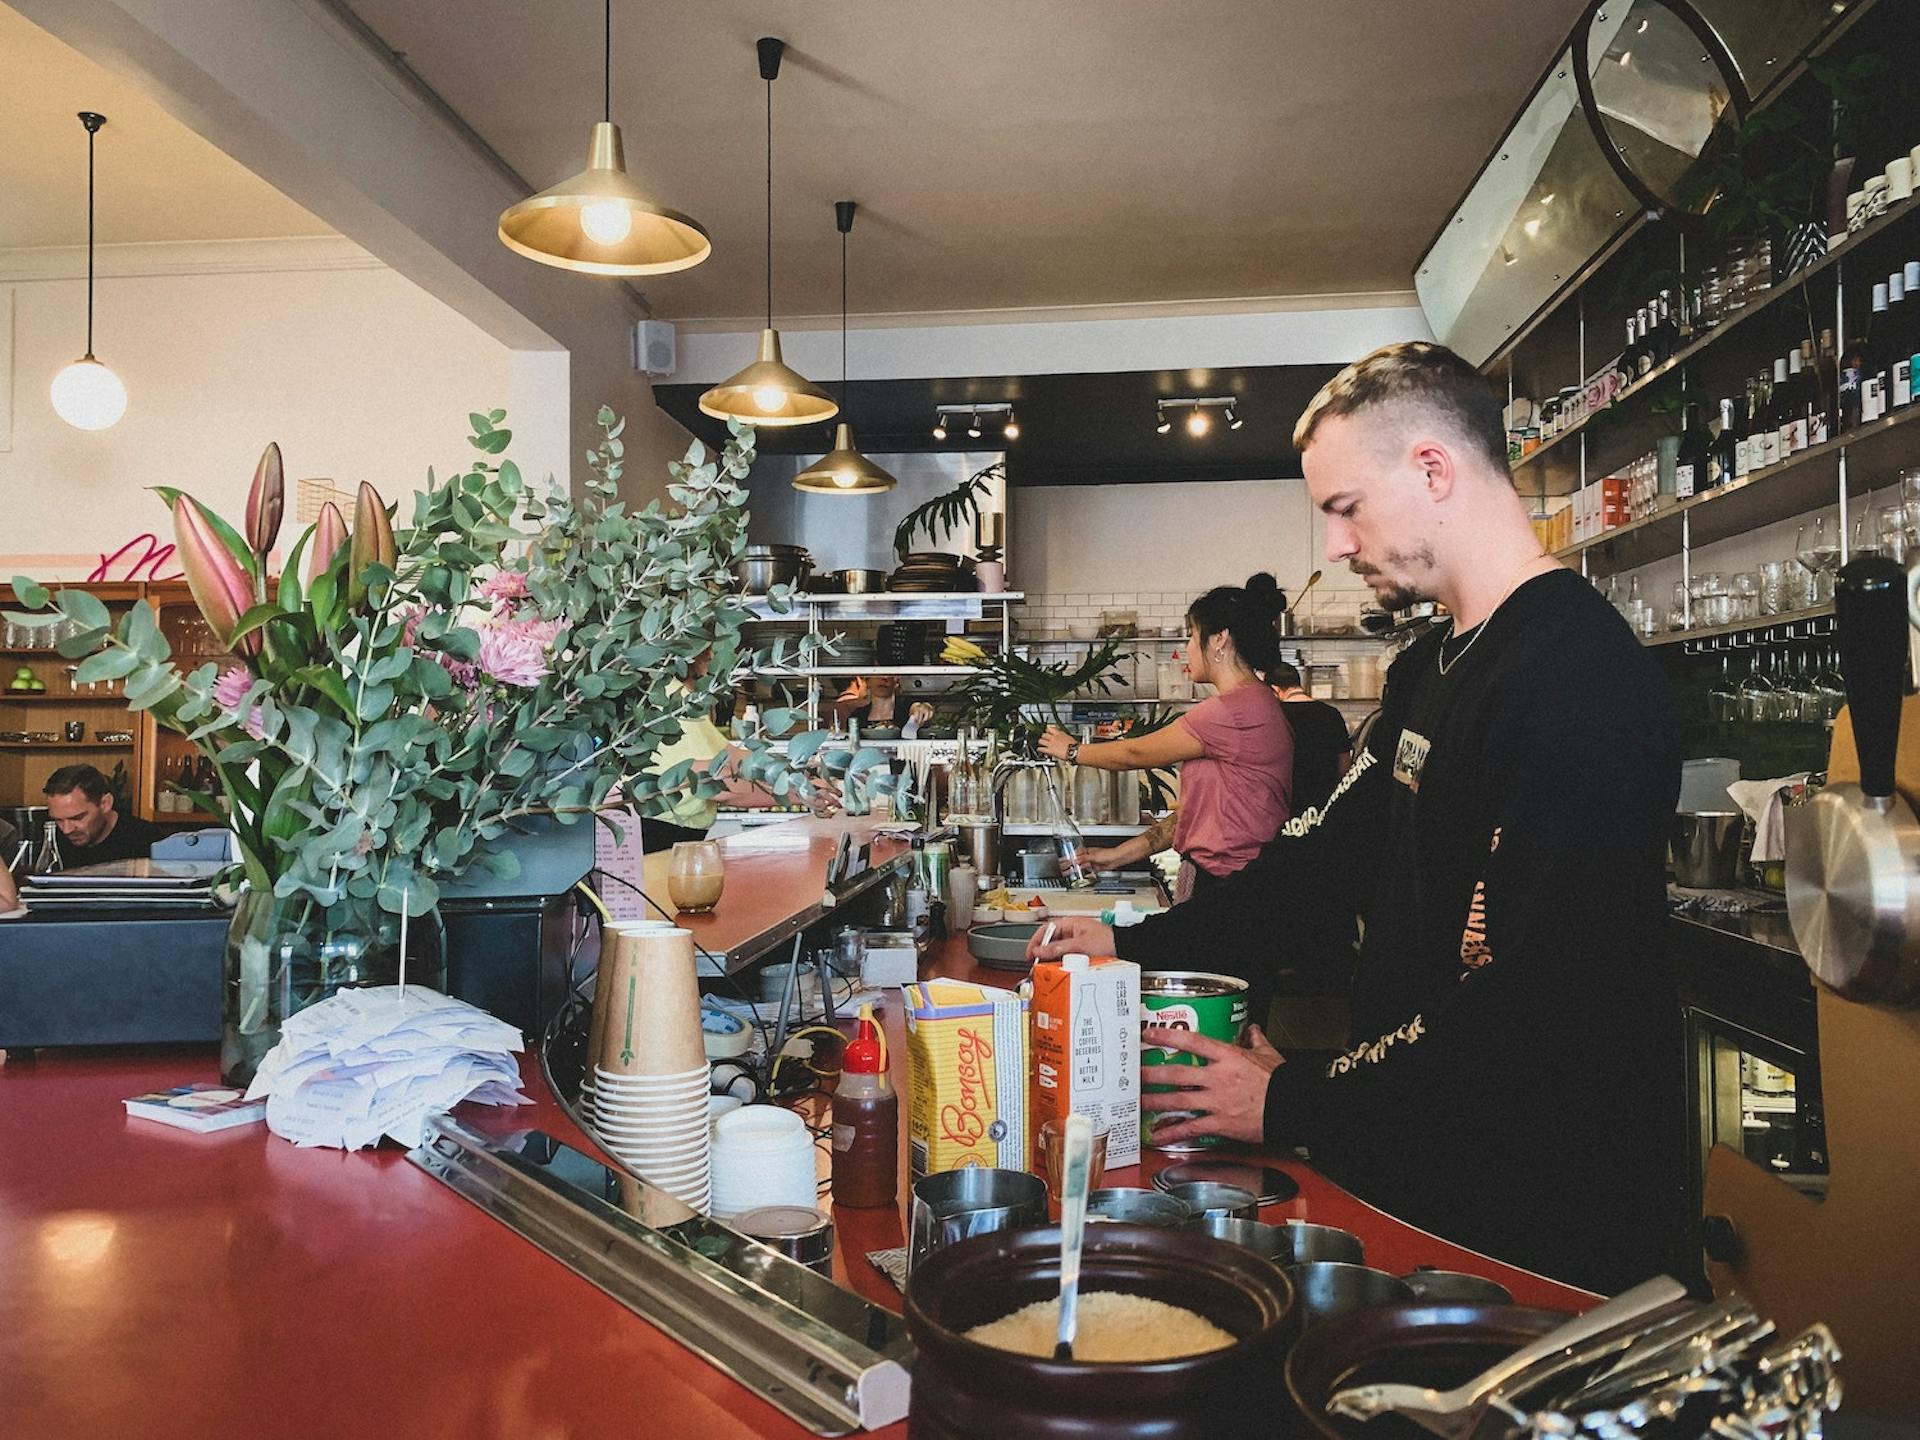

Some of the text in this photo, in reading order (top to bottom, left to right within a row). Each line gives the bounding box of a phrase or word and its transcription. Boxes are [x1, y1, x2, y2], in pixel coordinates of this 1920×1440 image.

[1083, 1017, 1093, 1027] THE
[1081, 1026, 1094, 1037] BEST
[1078, 1036, 1098, 1047] COFFEE
[1075, 1045, 1101, 1057] DESERVES
[1079, 1065, 1098, 1076] BETTER
[1082, 1075, 1095, 1084] MILK
[940, 1028, 992, 1147] Bonsoy
